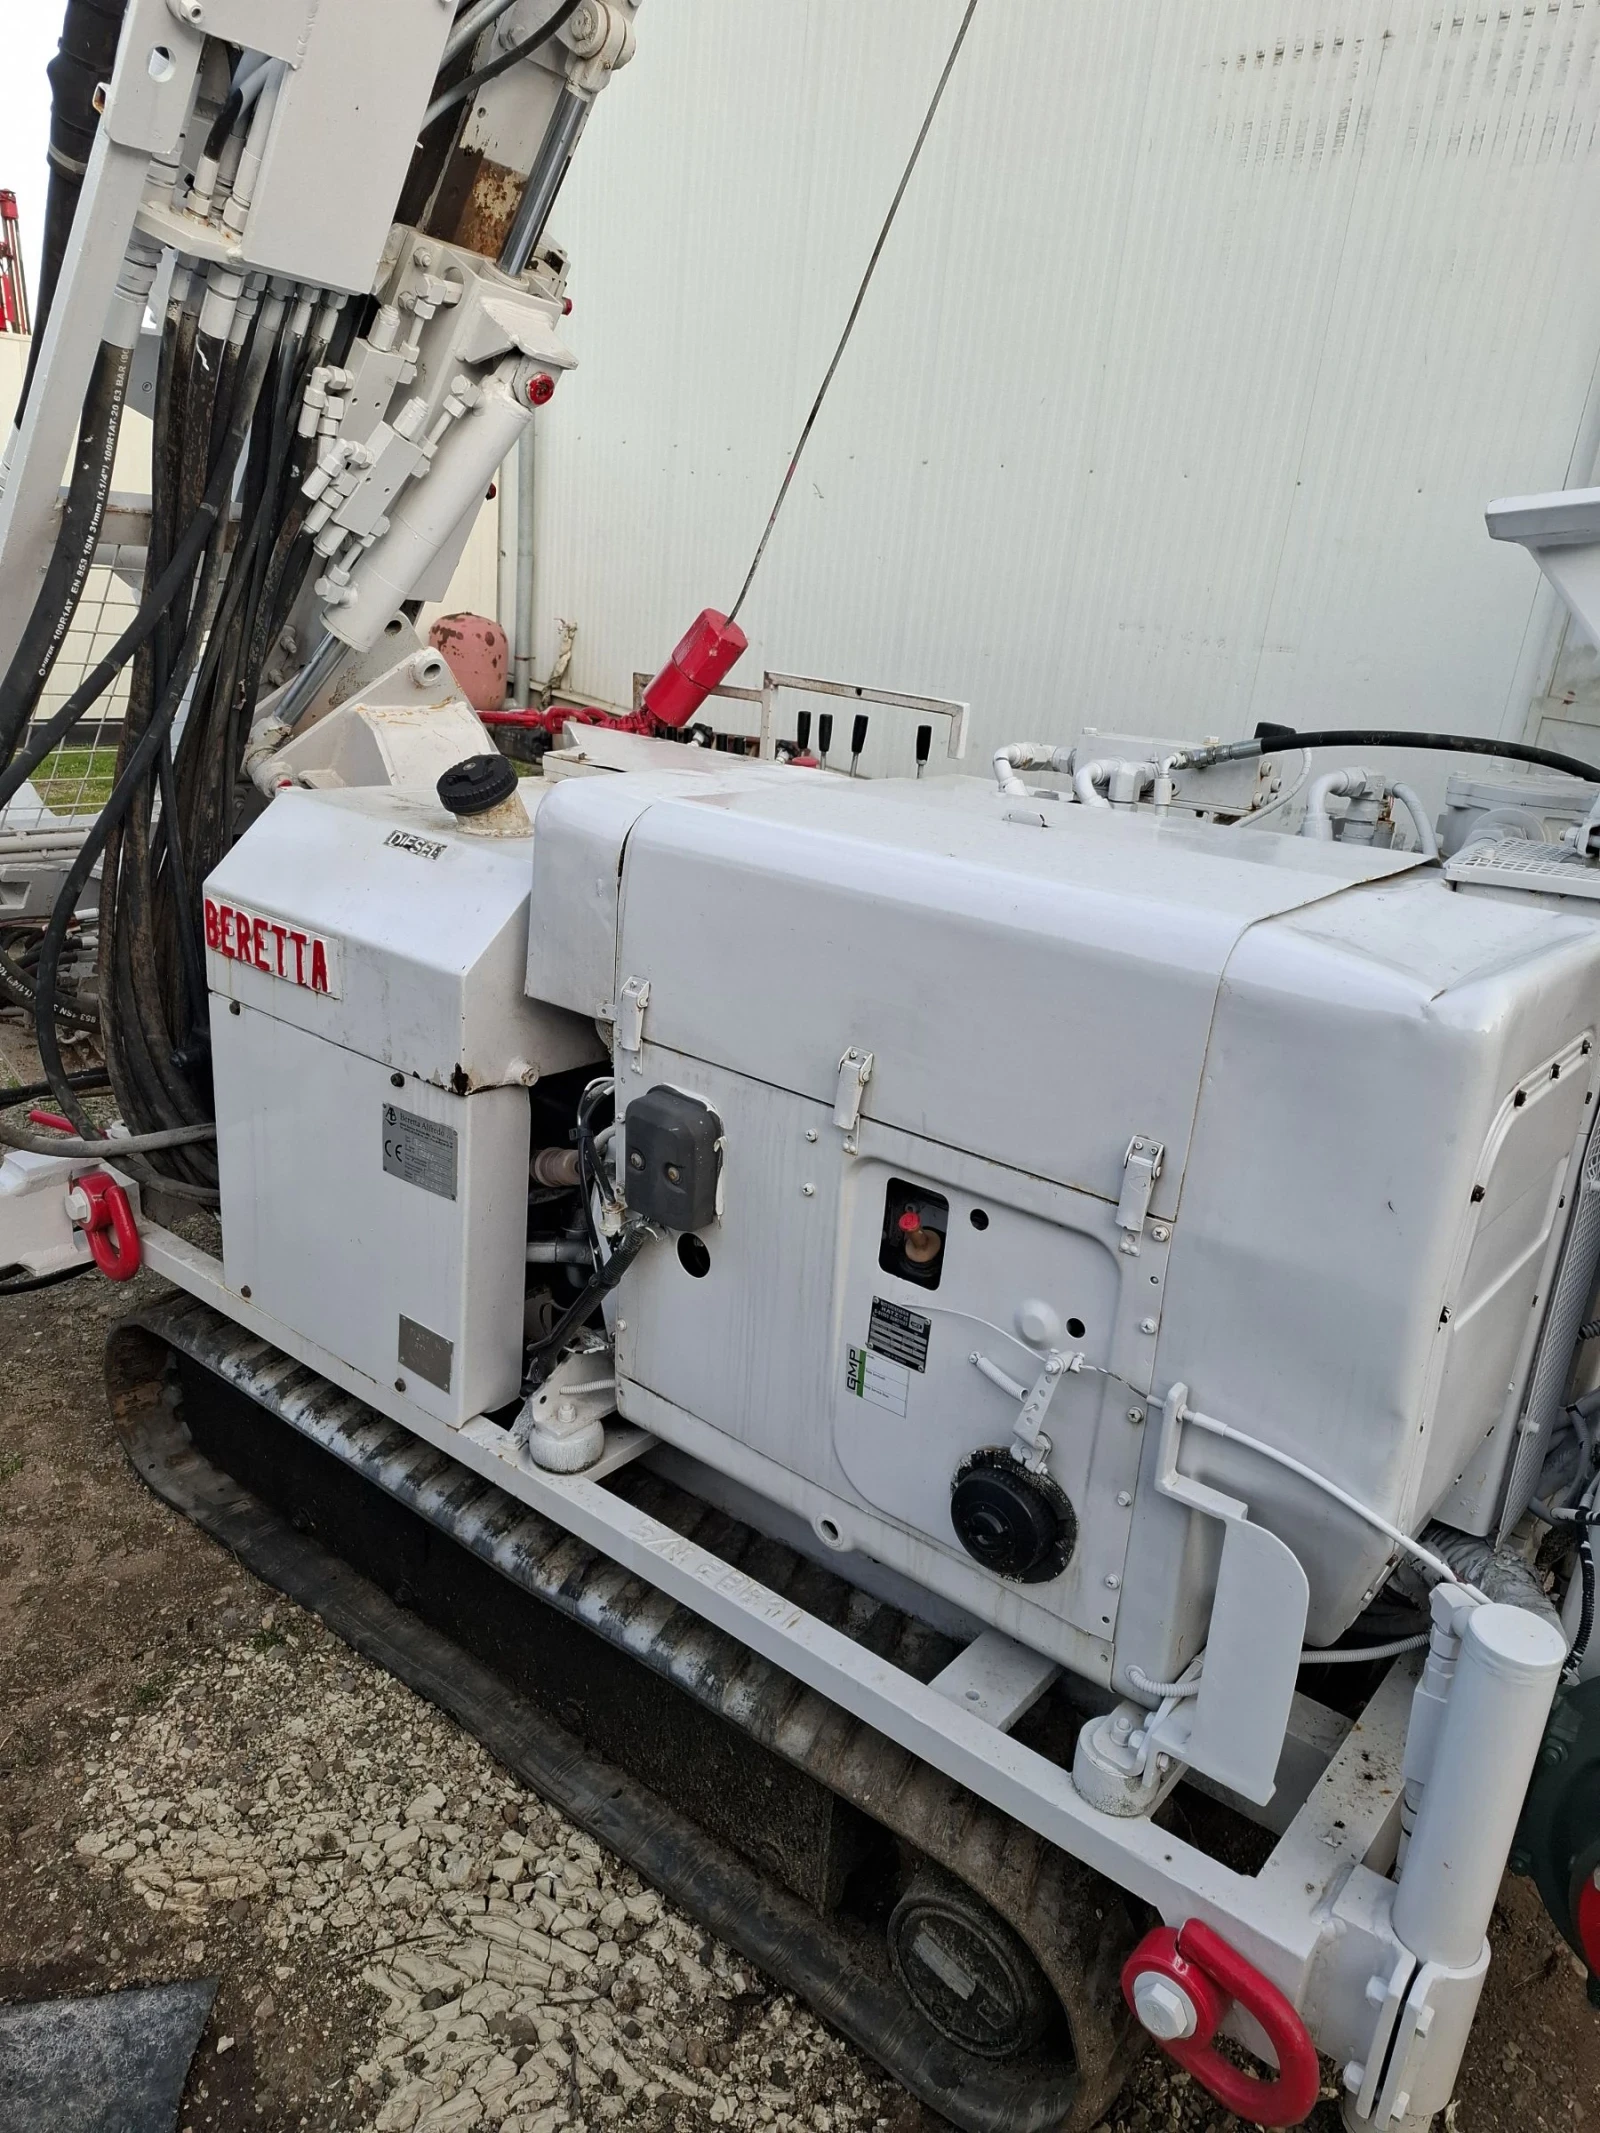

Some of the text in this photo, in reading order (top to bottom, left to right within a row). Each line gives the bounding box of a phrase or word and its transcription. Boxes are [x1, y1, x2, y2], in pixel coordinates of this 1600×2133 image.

[116, 365, 127, 387] BAR
[114, 389, 123, 402] 63
[103, 405, 120, 462] 100R1AT-20
[89, 503, 103, 533] 31mm
[83, 535, 96, 555] 1SN
[76, 558, 88, 577] 853
[71, 578, 82, 595] EN
[53, 598, 75, 641] 100R1AT
[388, 832, 439, 860] DIESEL
[205, 898, 330, 993] BERETTA
[421, 1122, 445, 1137] Alfredo
[847, 1349, 863, 1391] GMP
